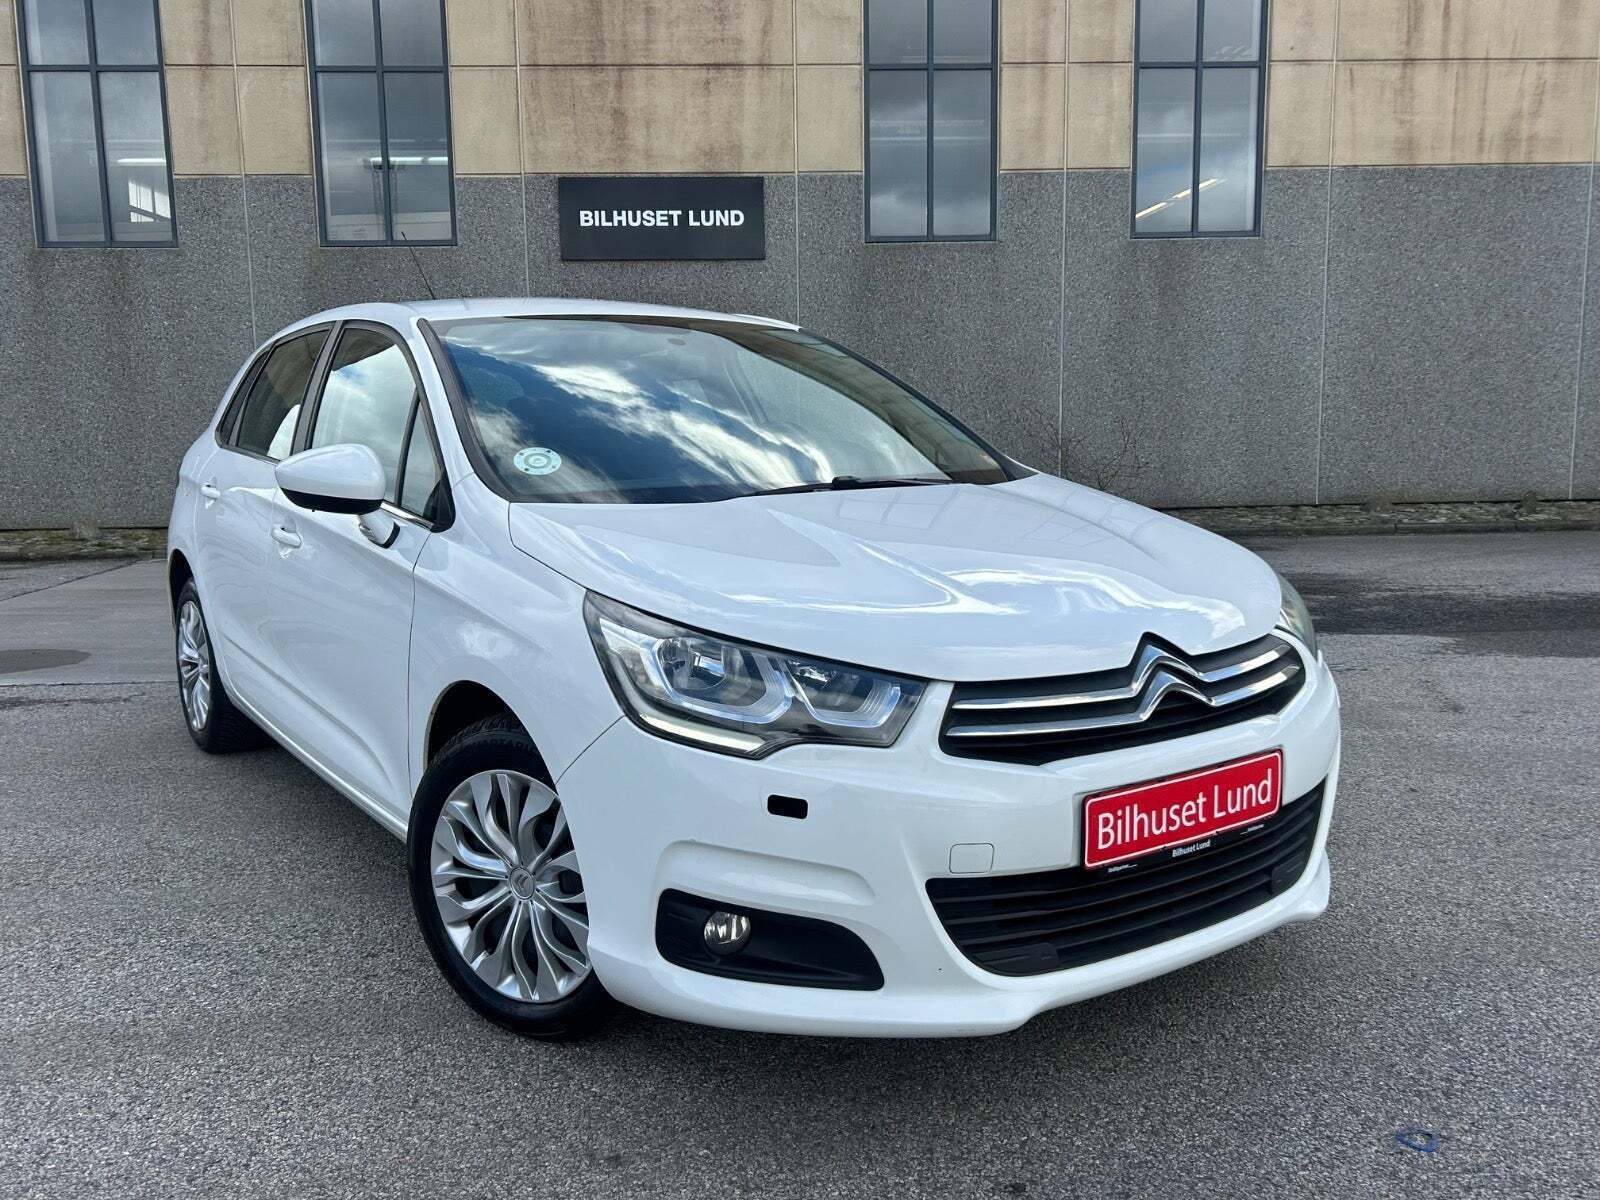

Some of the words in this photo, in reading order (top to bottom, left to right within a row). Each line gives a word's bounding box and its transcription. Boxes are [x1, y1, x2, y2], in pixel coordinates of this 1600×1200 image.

[579, 210, 682, 227] BILHUSET
[688, 210, 745, 226] LUND
[1097, 791, 1207, 850] Bilhuset
[1213, 768, 1272, 818] Lund
[1172, 844, 1196, 857] Bilhuset
[1196, 839, 1211, 850] Lund
